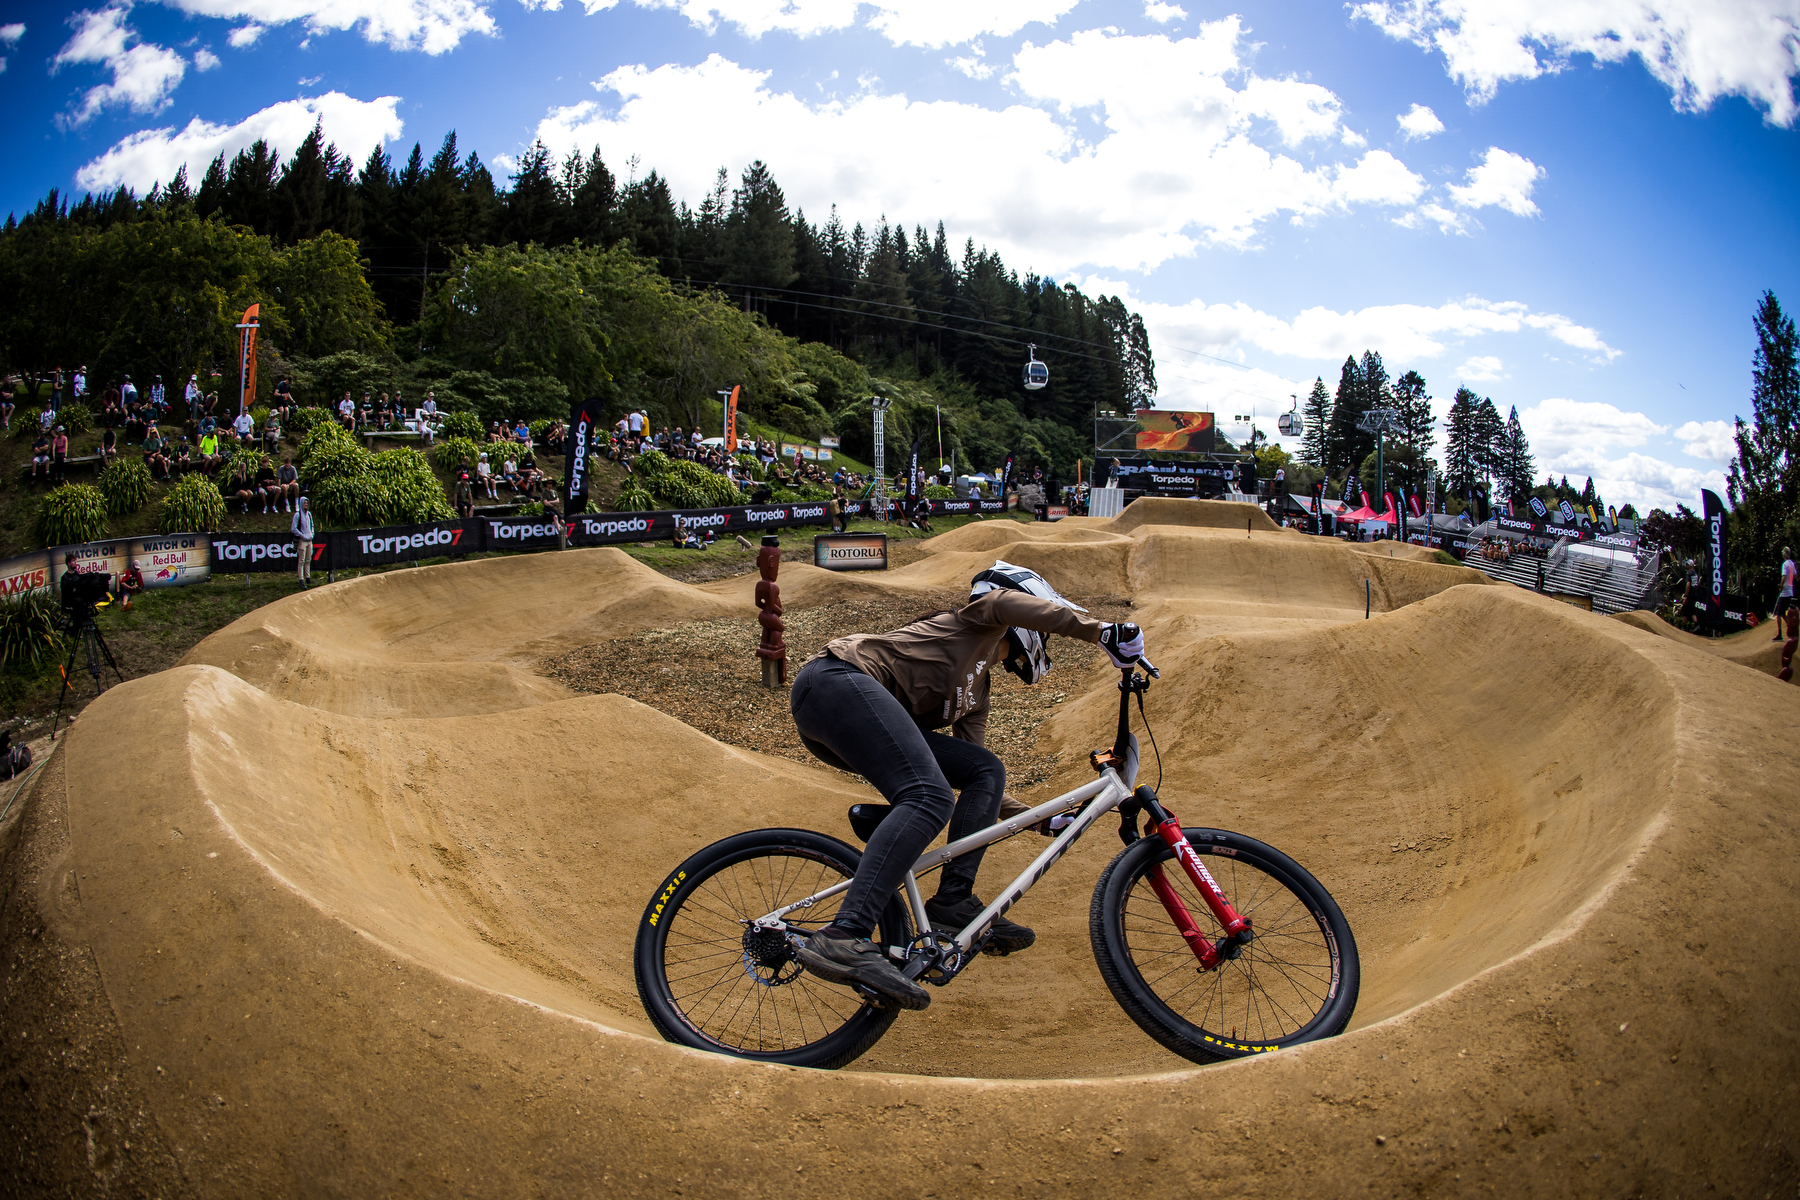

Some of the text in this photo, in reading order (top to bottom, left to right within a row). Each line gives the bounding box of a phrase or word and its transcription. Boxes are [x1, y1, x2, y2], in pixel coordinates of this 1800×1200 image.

[569, 410, 591, 500] Torpedo7
[909, 452, 918, 500] Torpedo7
[1151, 474, 1201, 485] Torpedo7
[1344, 475, 1355, 501] SMITH
[792, 506, 827, 519] Torpedo7
[844, 503, 864, 516] pedo7
[943, 501, 973, 511] Torpedo7
[980, 501, 1006, 510] Torpedo7
[672, 513, 731, 529] Torpedo7
[745, 508, 789, 523] Torpedo7
[489, 521, 577, 541] Torped7
[582, 517, 655, 536] Torpedo7
[1499, 516, 1536, 531] Torpedo7
[1545, 524, 1584, 539] Torpedo7
[143, 538, 196, 552] WATCH ON
[357, 527, 464, 554] Torpedo7
[1594, 532, 1637, 548] Torpedo7
[102, 546, 116, 556] ON
[153, 552, 187, 565] Red Bull
[212, 540, 327, 563] Torped7
[831, 547, 884, 558] ROTORUA
[75, 560, 108, 573] Red Bull
[1711, 512, 1723, 607] Torpedo7
[1184, 846, 1222, 893] BOMBER
[649, 870, 687, 926] MAXXIS
[1204, 1035, 1279, 1053] MAXXIS
